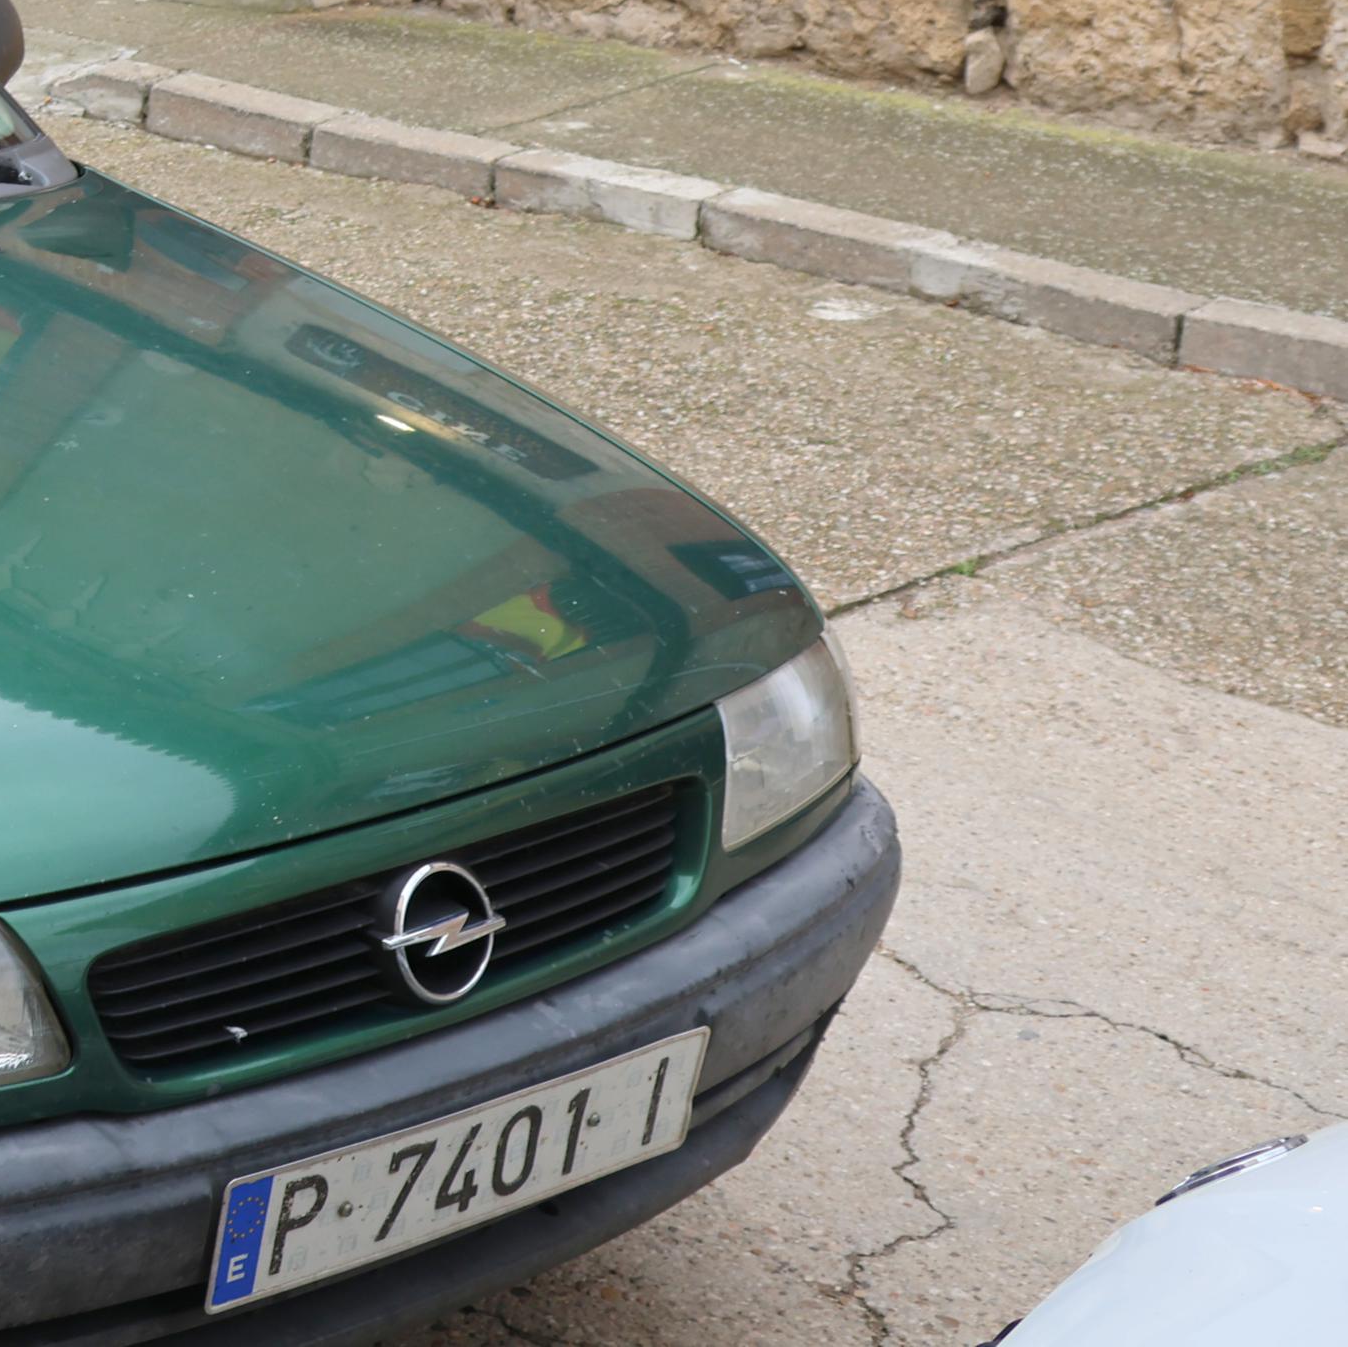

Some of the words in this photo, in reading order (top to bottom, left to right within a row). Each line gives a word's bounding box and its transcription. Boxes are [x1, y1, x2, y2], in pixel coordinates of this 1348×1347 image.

[268, 1175, 329, 1277] P
[373, 1087, 592, 1243] 7401
[226, 1252, 249, 1284] E
